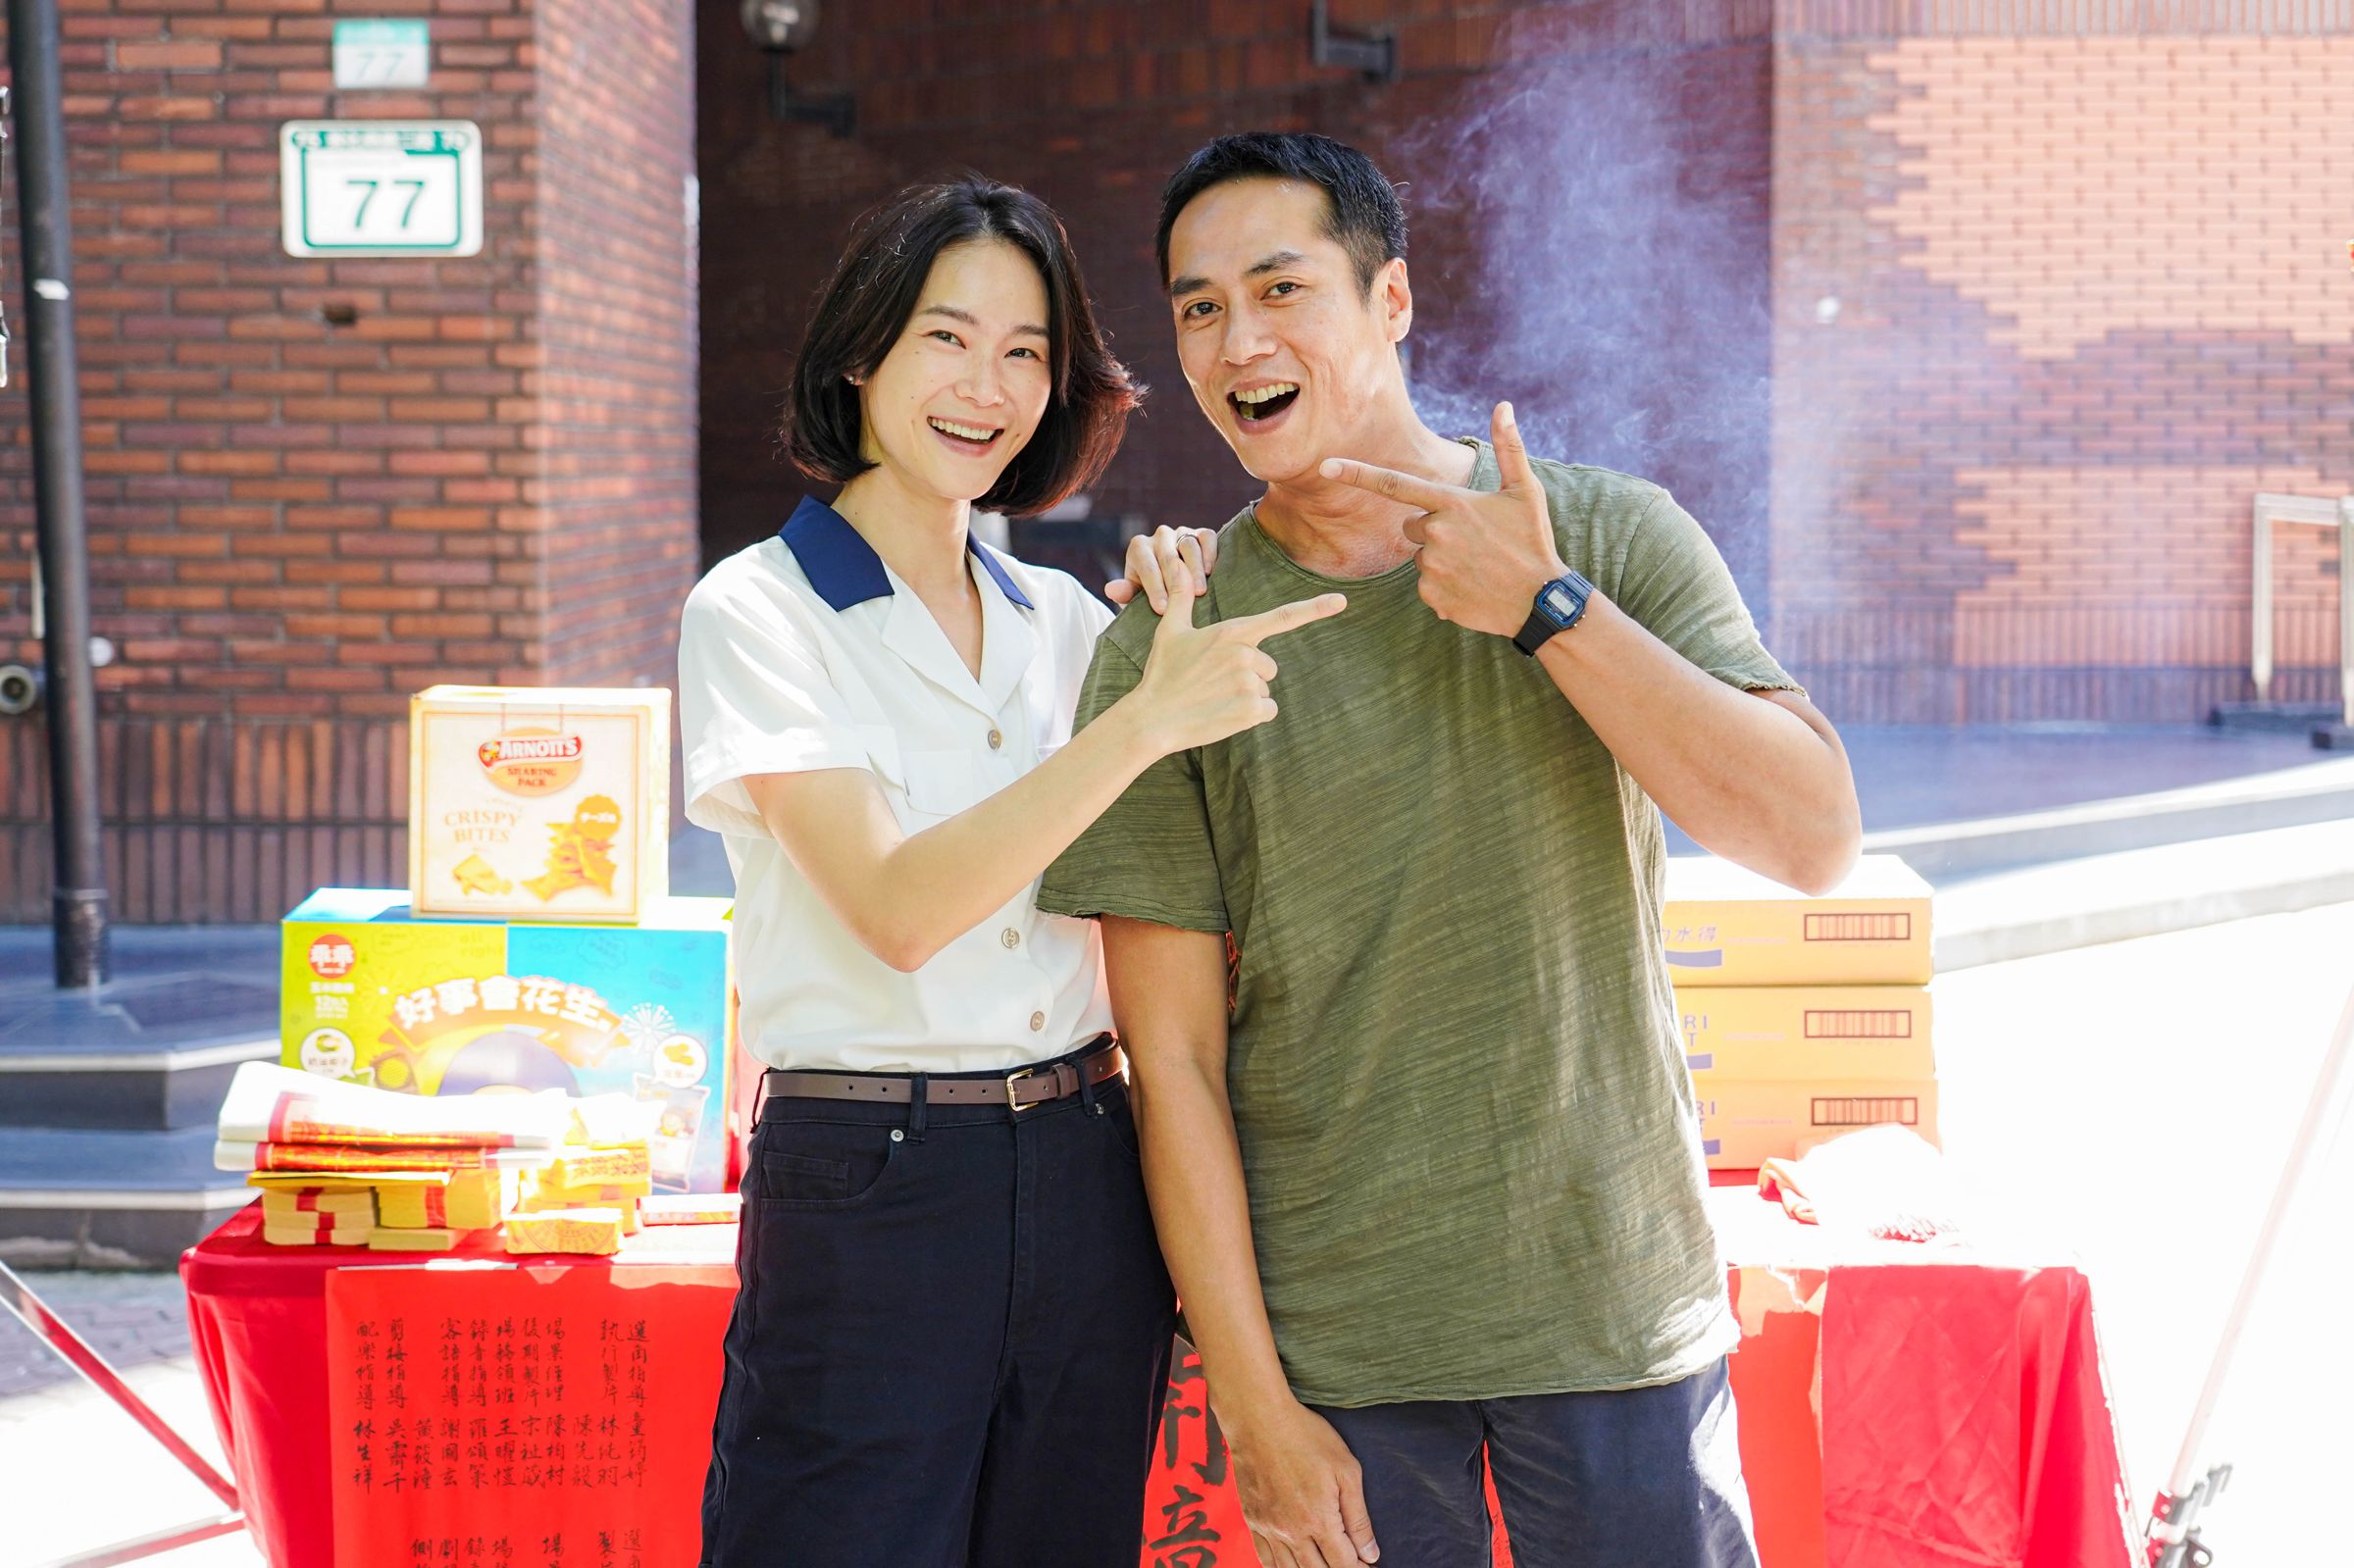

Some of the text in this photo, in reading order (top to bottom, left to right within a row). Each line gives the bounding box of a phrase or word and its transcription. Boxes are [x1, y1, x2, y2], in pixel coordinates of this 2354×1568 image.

[356, 52, 405, 79] 77
[346, 179, 425, 228] 77
[507, 768, 556, 777] SHARING
[518, 778, 546, 786] PACK
[443, 810, 519, 827] CRISPY
[454, 829, 509, 842] BITES
[310, 943, 355, 969] 乖乖
